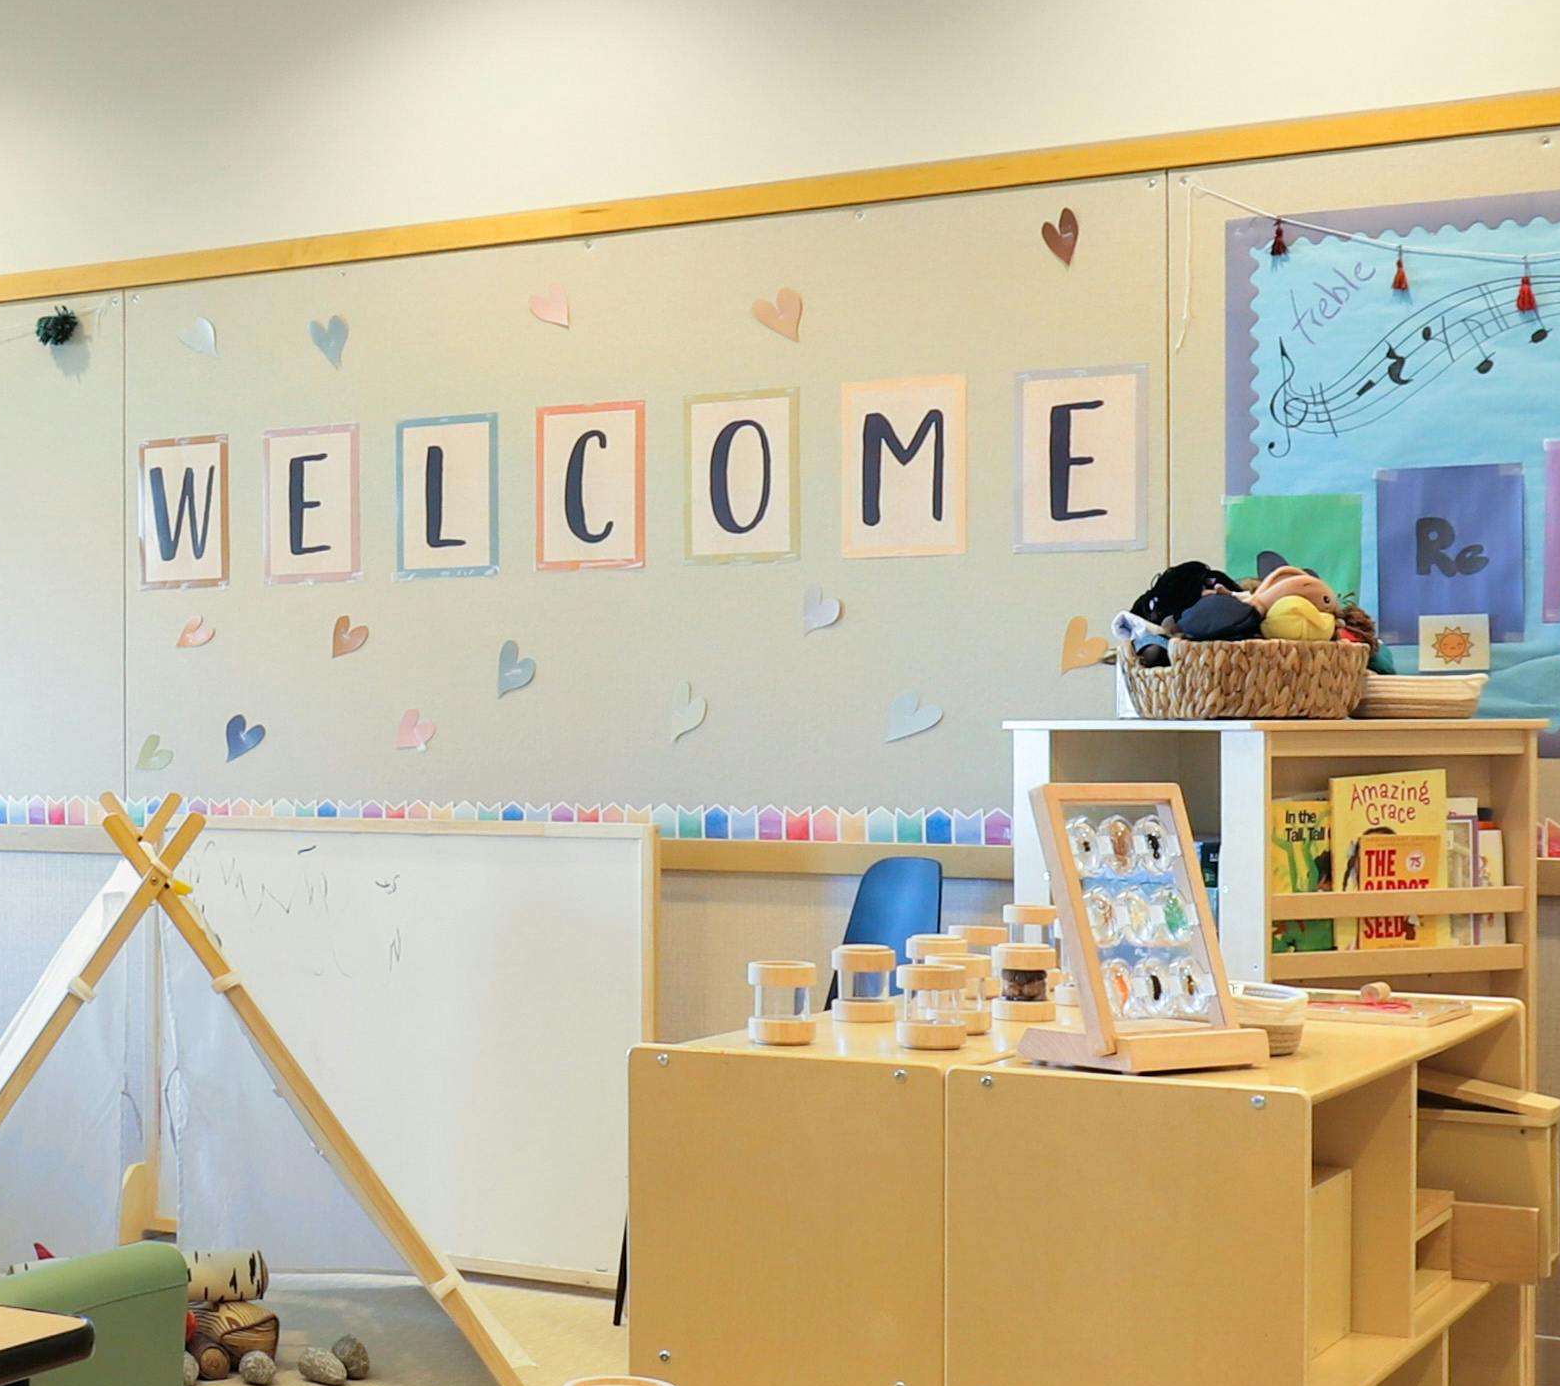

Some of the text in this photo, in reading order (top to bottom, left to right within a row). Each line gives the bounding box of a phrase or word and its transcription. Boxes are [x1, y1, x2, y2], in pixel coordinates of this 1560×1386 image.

[1291, 259, 1377, 345] treble
[149, 400, 1108, 562] WELCOME
[1415, 516, 1490, 578] Re
[1350, 780, 1431, 811] Amazing
[1285, 809, 1317, 824] In the
[1365, 803, 1417, 826] Grace
[1307, 826, 1326, 842] Tall
[1364, 849, 1396, 878] THE
[1410, 856, 1423, 869] 75
[1363, 915, 1407, 940] SEED
